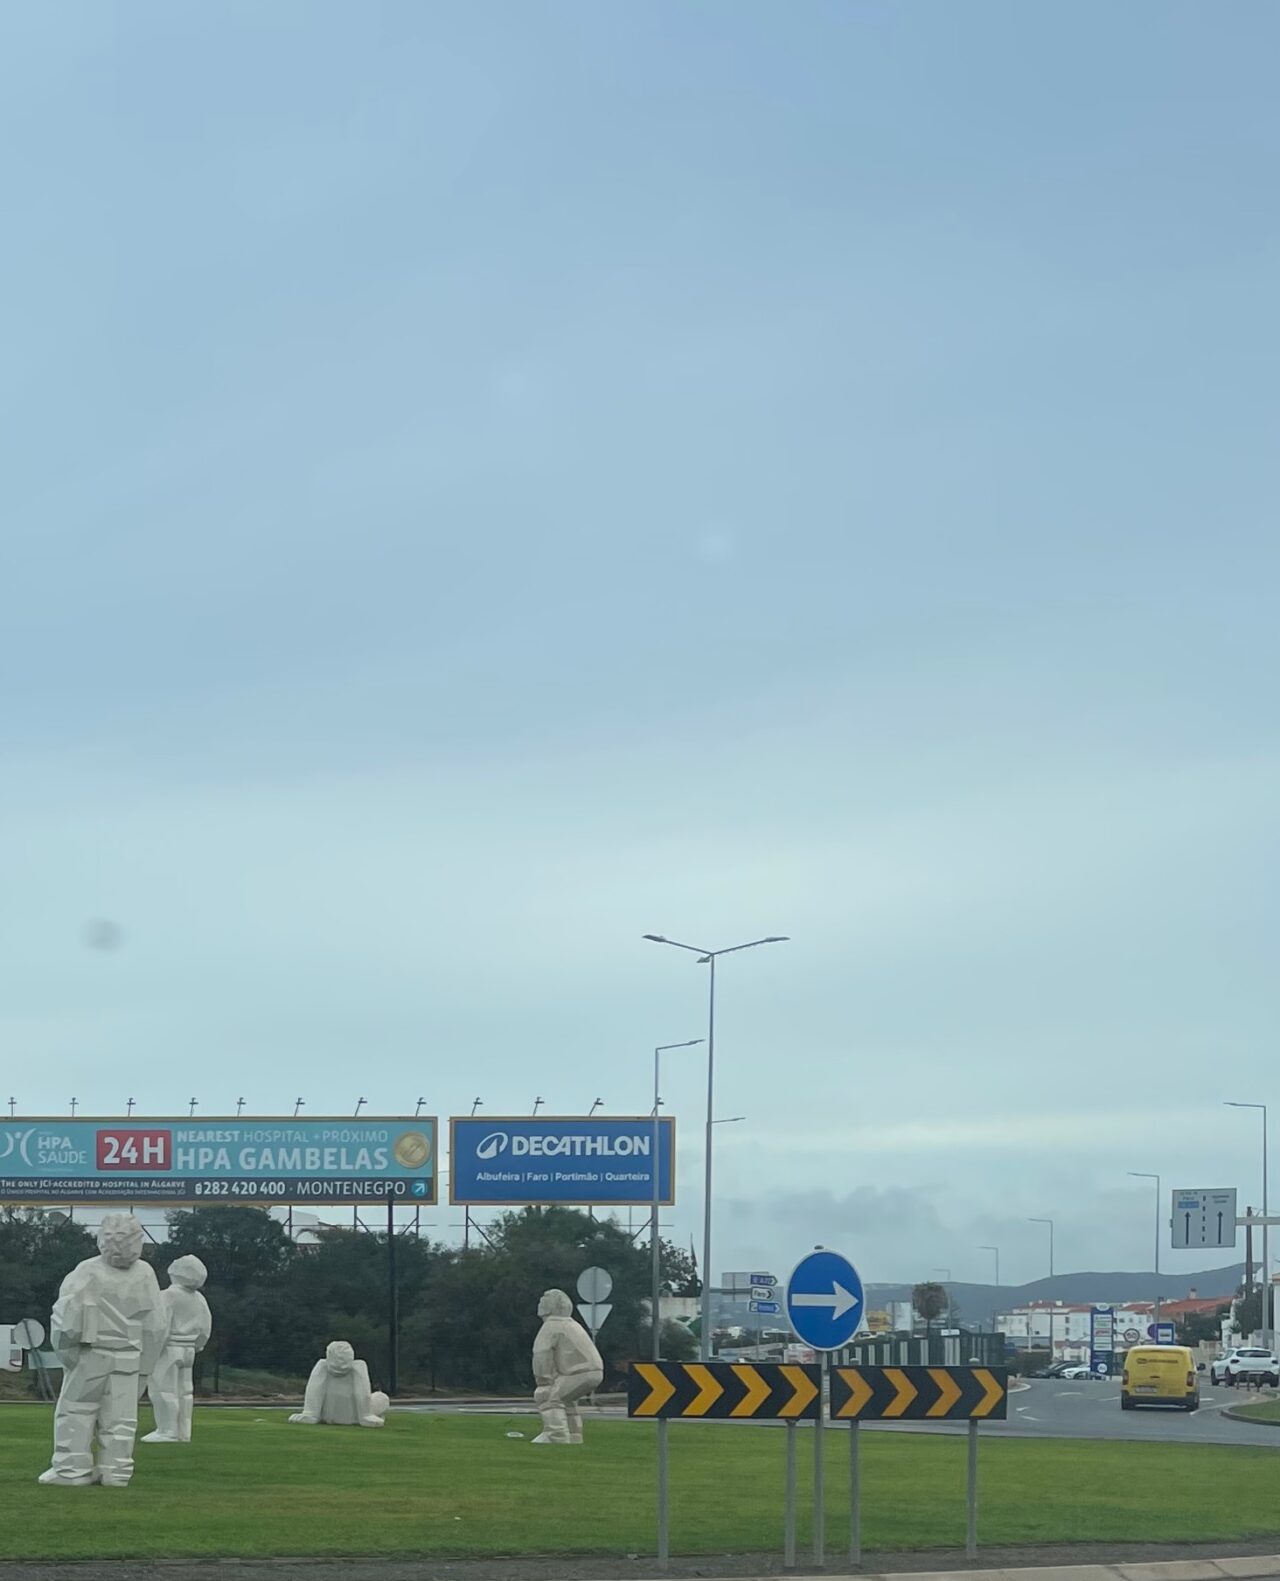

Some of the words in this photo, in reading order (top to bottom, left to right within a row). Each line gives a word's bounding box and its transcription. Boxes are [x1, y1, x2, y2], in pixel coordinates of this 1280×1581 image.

[38, 1136, 73, 1150] HPA
[177, 1130, 240, 1143] NEAREST
[243, 1130, 309, 1143] HOSPITAL
[103, 1136, 165, 1164] 24H
[512, 1135, 650, 1156] DECATHLON
[177, 1147, 232, 1170] HPA
[239, 1147, 389, 1170] GAMBELAS
[476, 1172, 520, 1181] Albufeira
[527, 1172, 549, 1181] Faro
[555, 1172, 598, 1181] Portimão
[605, 1172, 650, 1181] Quarteira
[18, 1180, 38, 1188] ONLY
[102, 1180, 139, 1188] HOSPITAL
[141, 1180, 149, 1188] IN
[203, 1181, 229, 1195] 282
[231, 1181, 257, 1195] 420
[260, 1181, 285, 1195] 400
